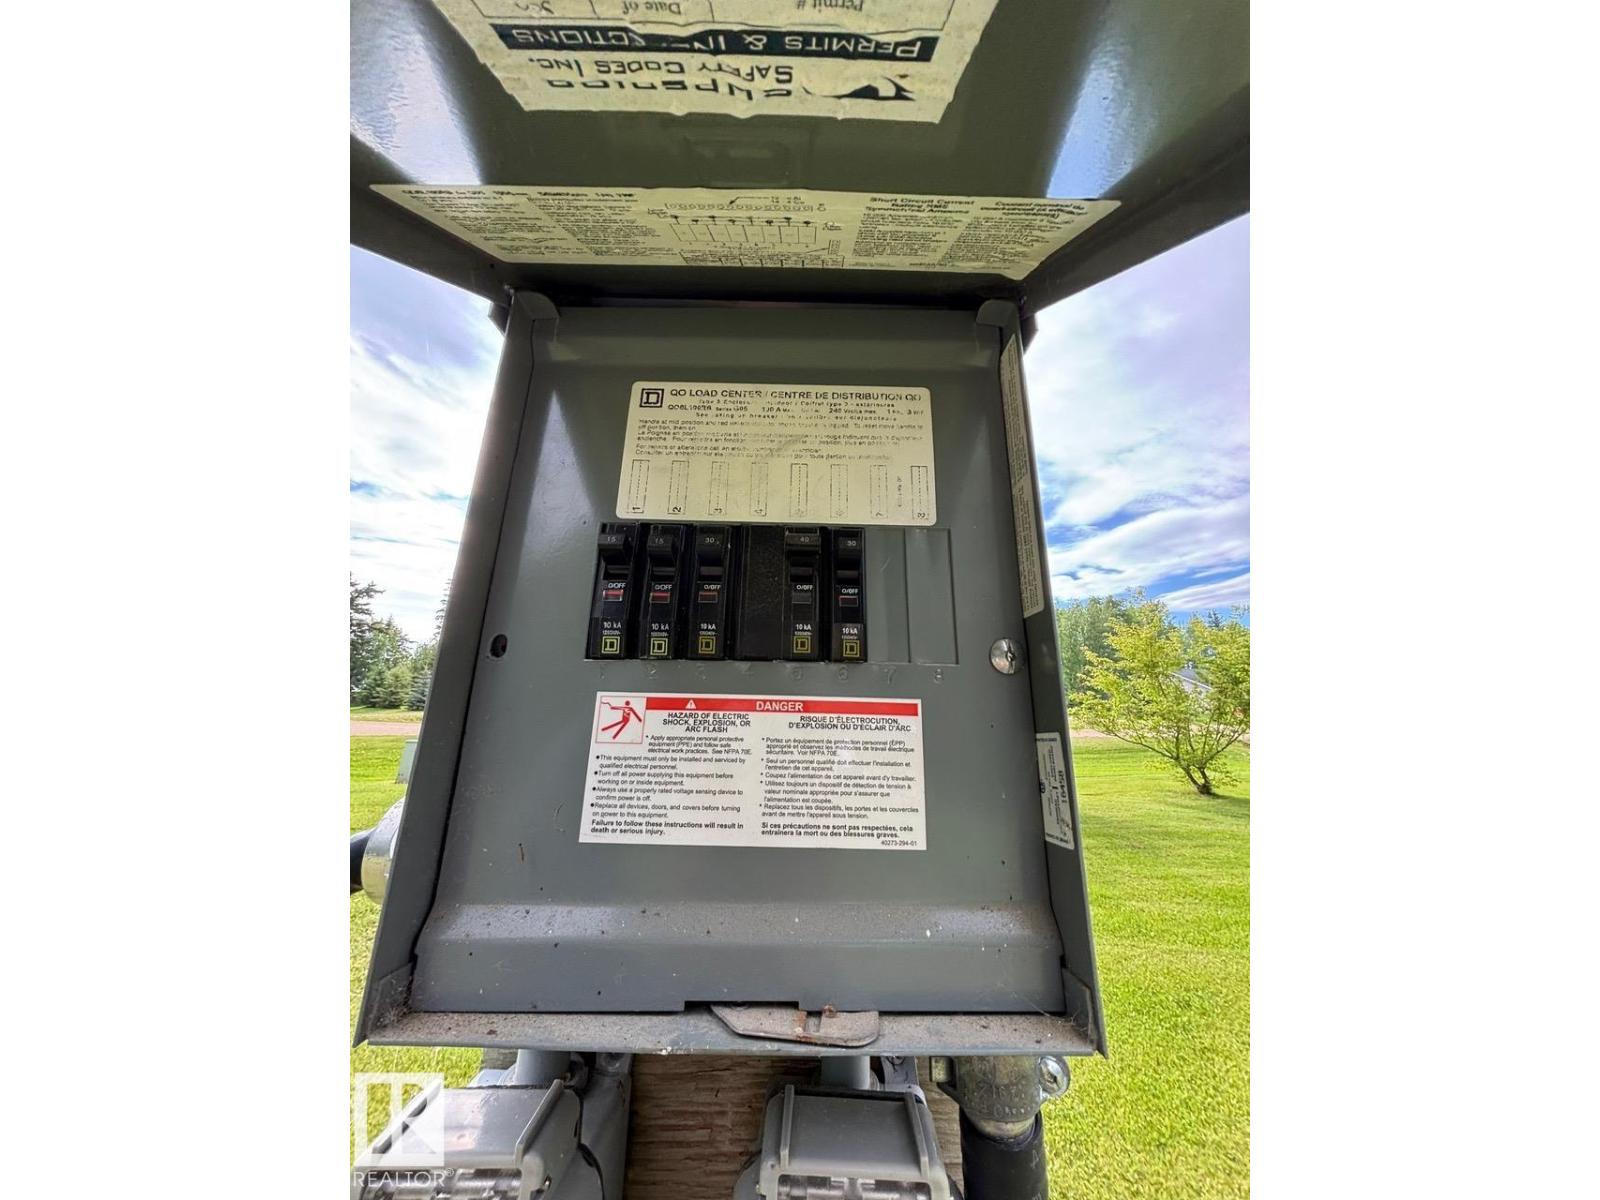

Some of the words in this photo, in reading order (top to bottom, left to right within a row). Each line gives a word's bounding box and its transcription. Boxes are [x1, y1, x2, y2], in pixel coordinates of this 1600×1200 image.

[623, 1, 640, 15] of
[645, 1, 682, 15] Date
[742, 34, 768, 50] &
[785, 34, 922, 58] PERMITS
[528, 58, 584, 77] INC.
[594, 60, 685, 74] CODES
[721, 390, 762, 398] CENTER
[832, 392, 902, 400] DISTRIBUTION
[756, 701, 804, 711] DANGER
[693, 719, 738, 727] EXPLOSION,
[800, 716, 828, 724] RISQUE
[645, 827, 665, 836] injury.
[783, 822, 821, 831] précautions
[861, 824, 898, 832] respectées,
